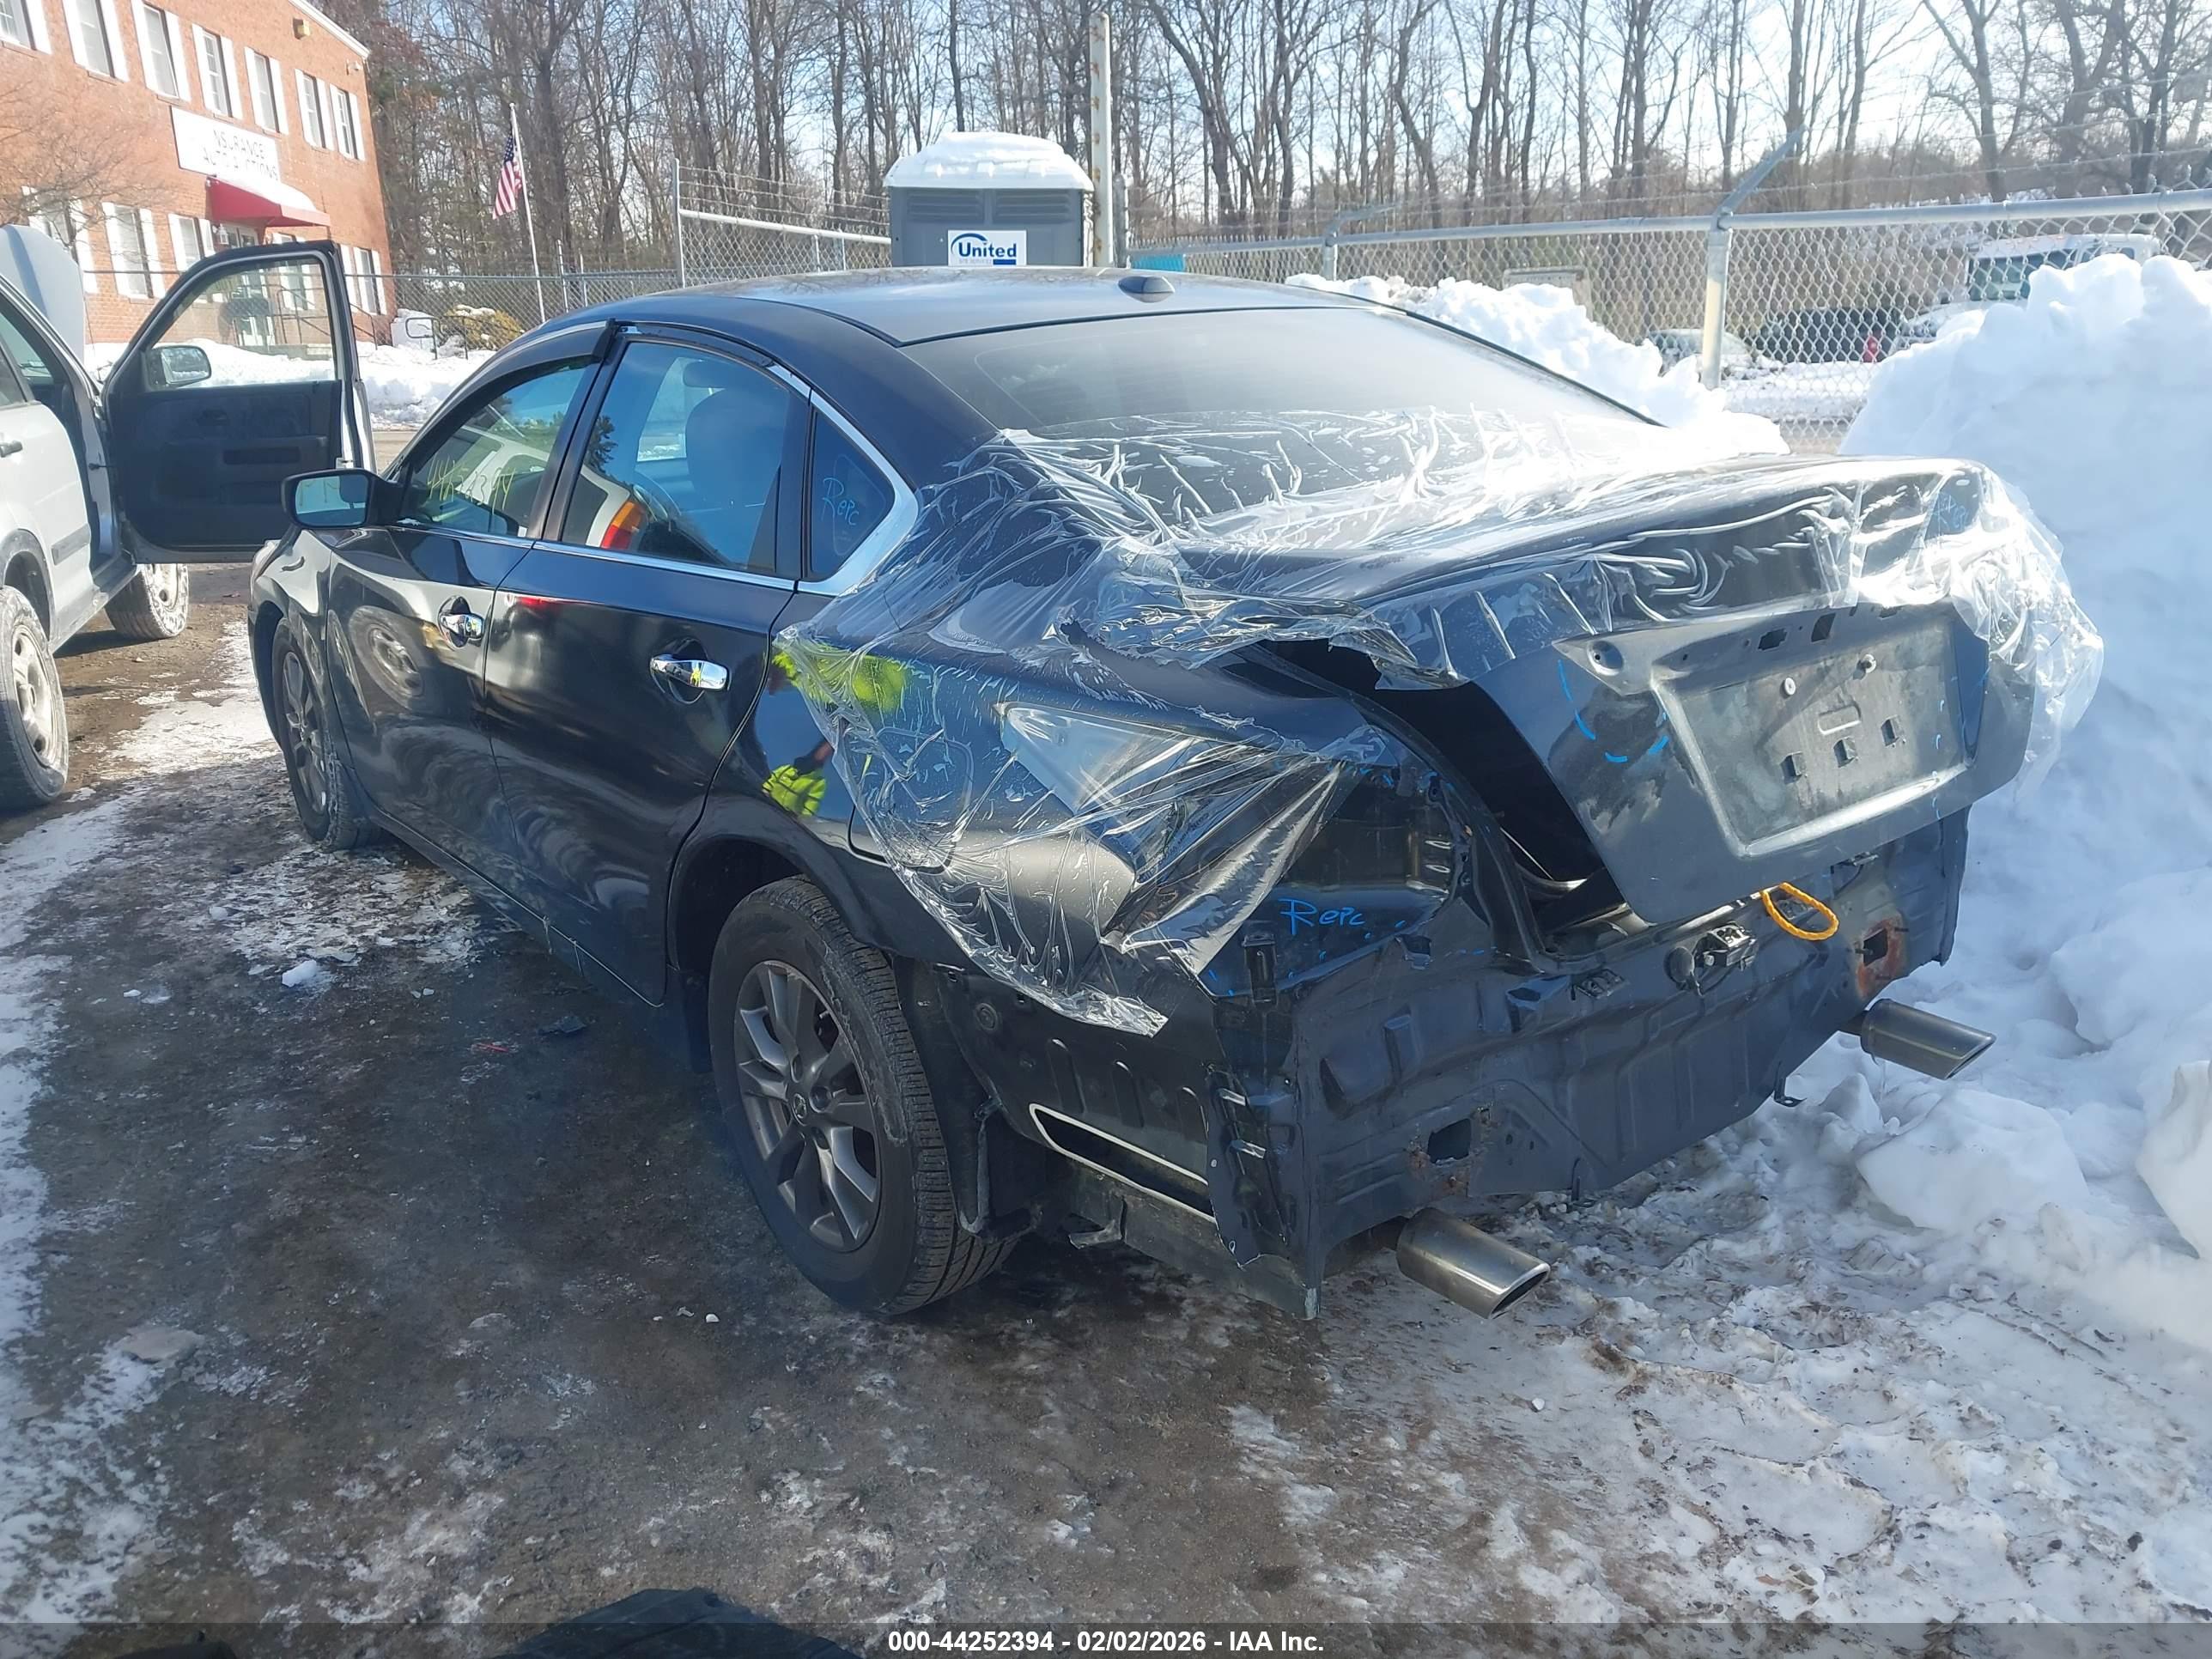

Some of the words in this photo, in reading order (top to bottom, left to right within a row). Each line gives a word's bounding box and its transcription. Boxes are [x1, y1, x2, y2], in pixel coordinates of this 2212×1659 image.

[211, 128, 266, 160] NSURANCE
[233, 155, 279, 182] ACTIONS
[958, 241, 1018, 258] United
